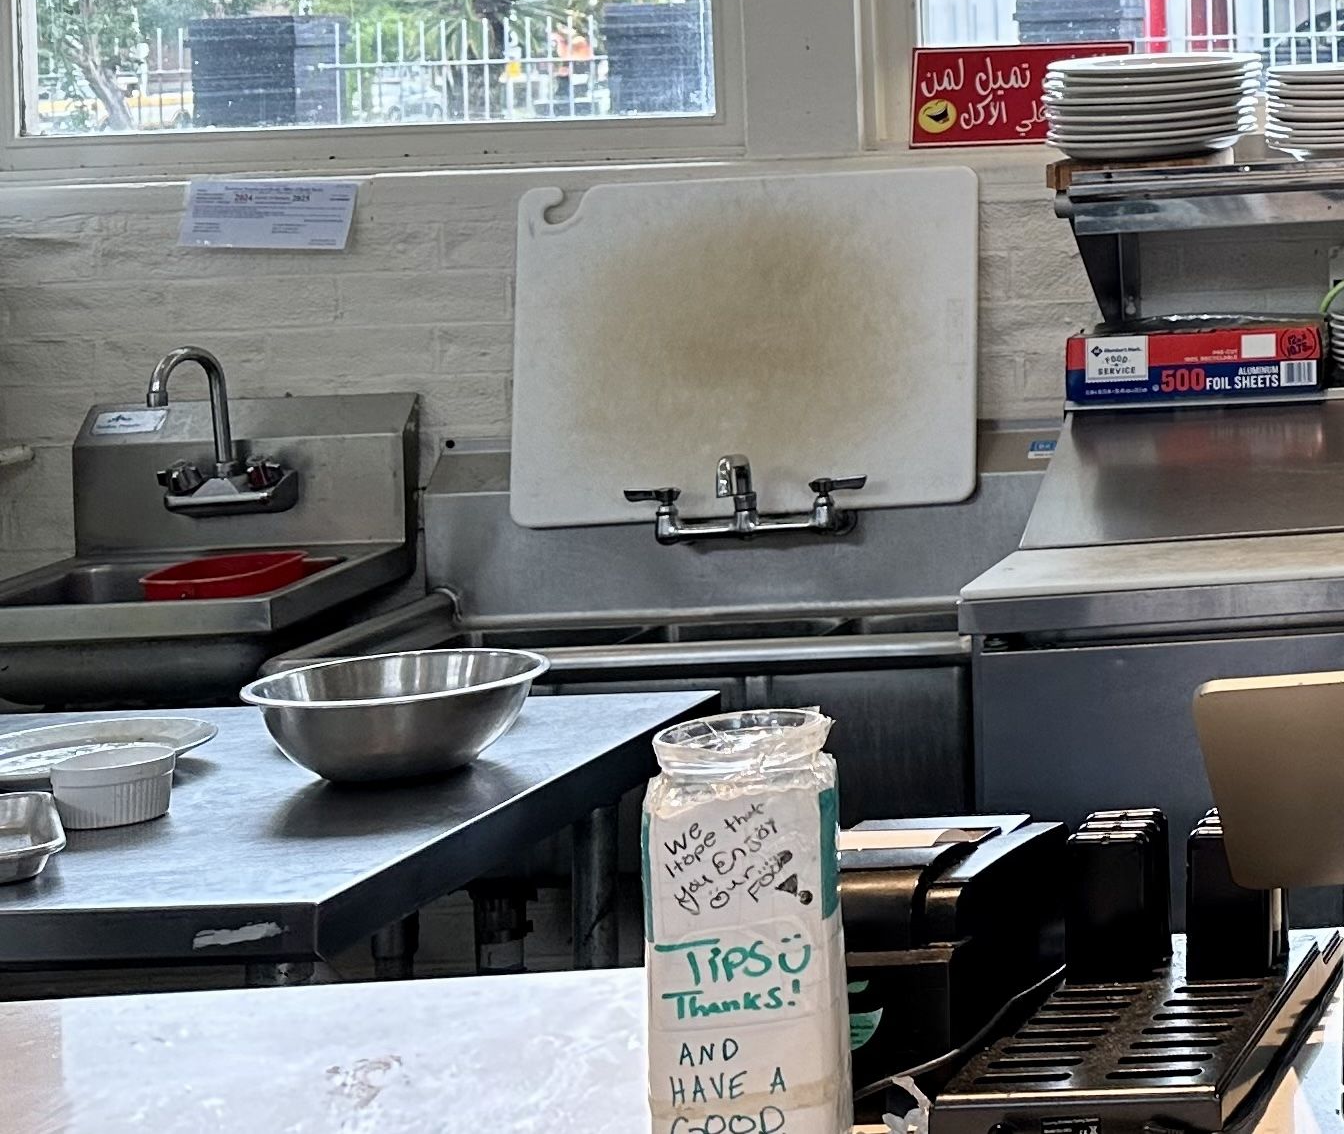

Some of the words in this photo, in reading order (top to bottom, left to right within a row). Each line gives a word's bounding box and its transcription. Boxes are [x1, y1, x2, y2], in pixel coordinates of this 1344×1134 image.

[1104, 355, 1129, 364] FOOD
[1098, 366, 1136, 375] SERVICE
[1238, 366, 1279, 375] ALUMINUM
[1160, 368, 1206, 393] 500
[1206, 377, 1232, 390] FOIL
[1234, 374, 1279, 389] SHEETS
[680, 1038, 740, 1067] AND
[670, 1071, 747, 1107] HAVE
[770, 1067, 787, 1096] A
